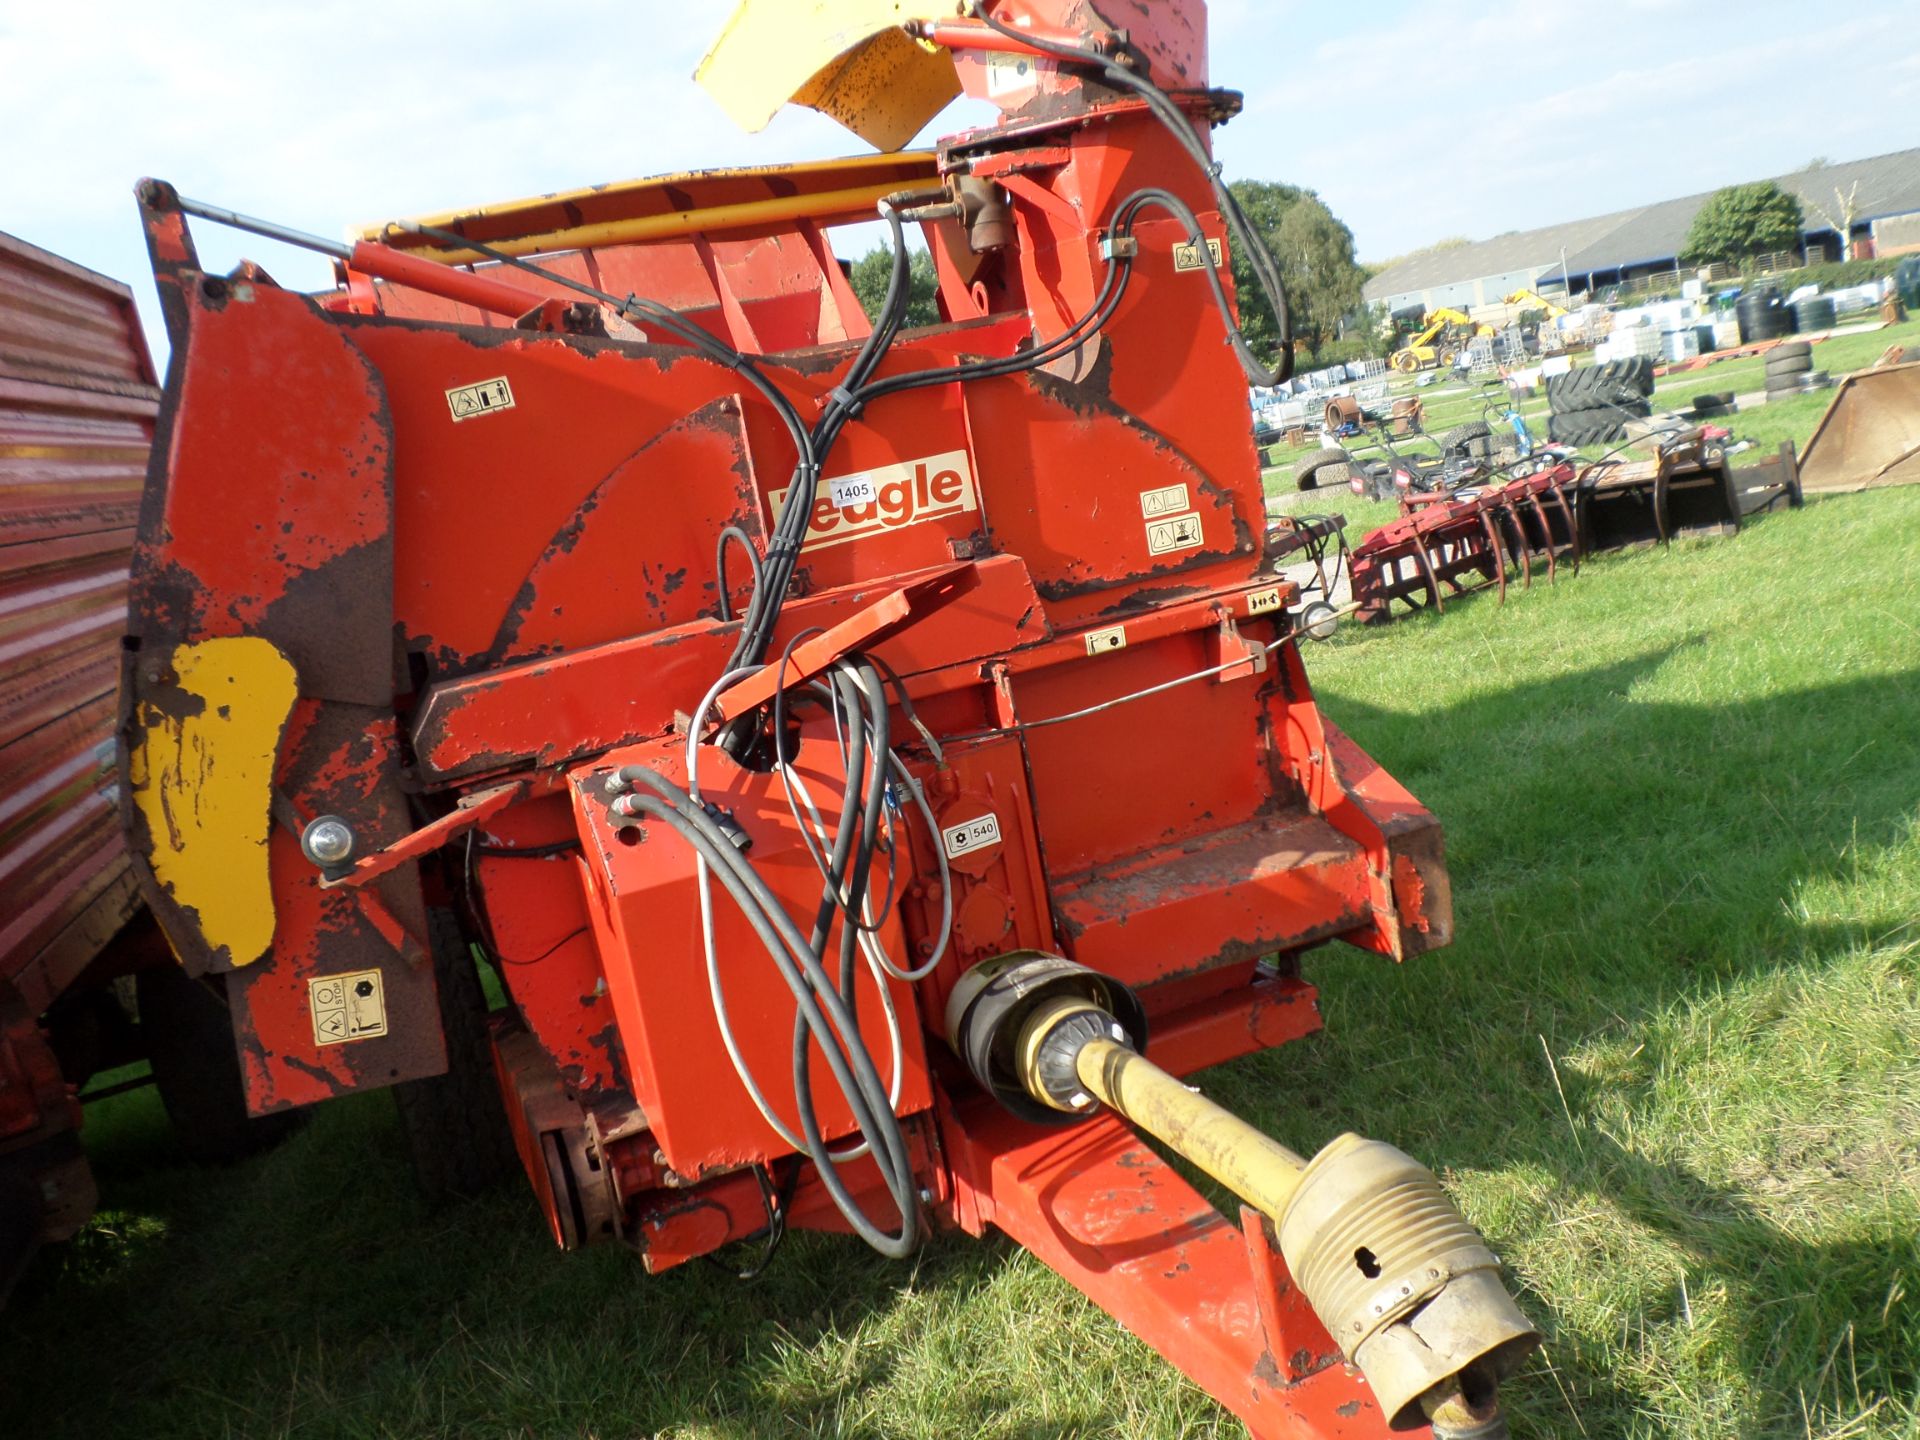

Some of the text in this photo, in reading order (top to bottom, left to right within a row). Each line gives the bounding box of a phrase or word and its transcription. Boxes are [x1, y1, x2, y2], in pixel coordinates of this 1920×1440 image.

[779, 463, 963, 532] eagle
[836, 483, 869, 501] 1405
[973, 823, 994, 838] 540
[332, 981, 343, 1005] STOP
